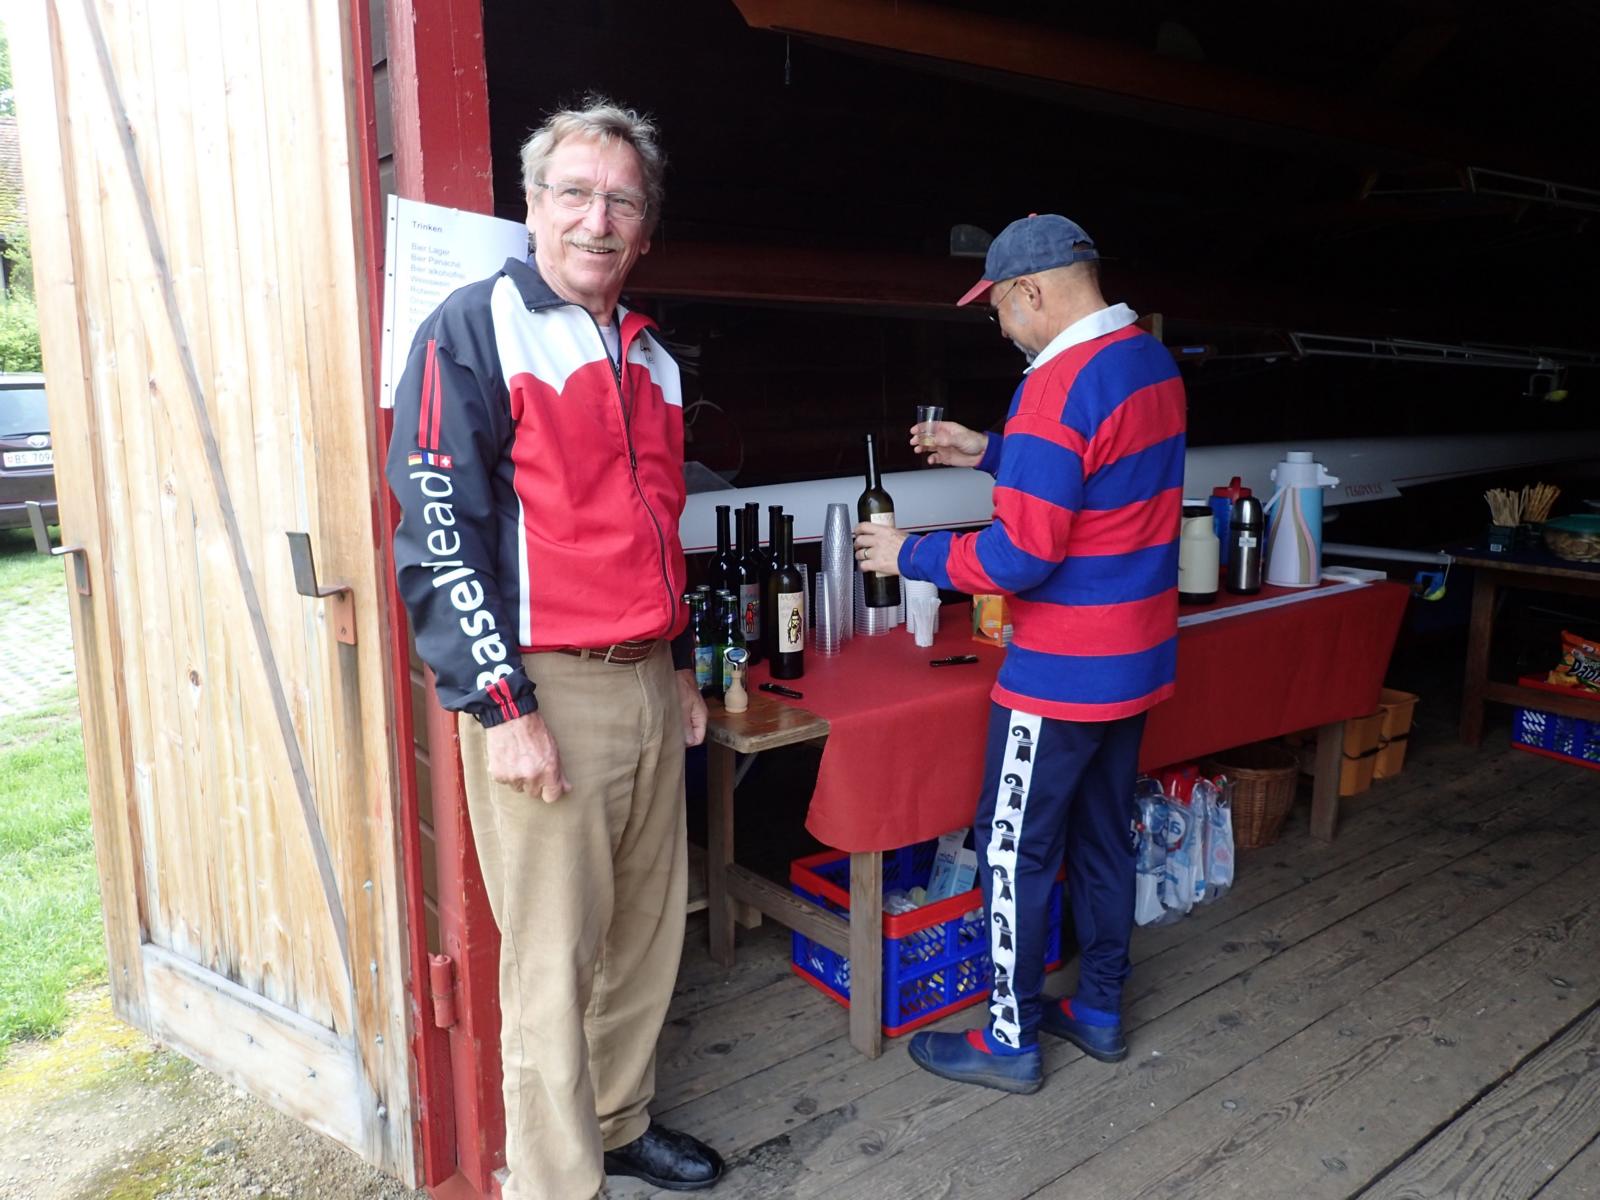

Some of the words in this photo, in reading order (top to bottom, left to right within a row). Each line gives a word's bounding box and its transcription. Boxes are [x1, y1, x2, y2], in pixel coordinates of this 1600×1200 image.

[412, 220, 443, 233] Trinken
[411, 242, 427, 251] Bier
[428, 245, 450, 256] Lager
[411, 253, 426, 262] Bier
